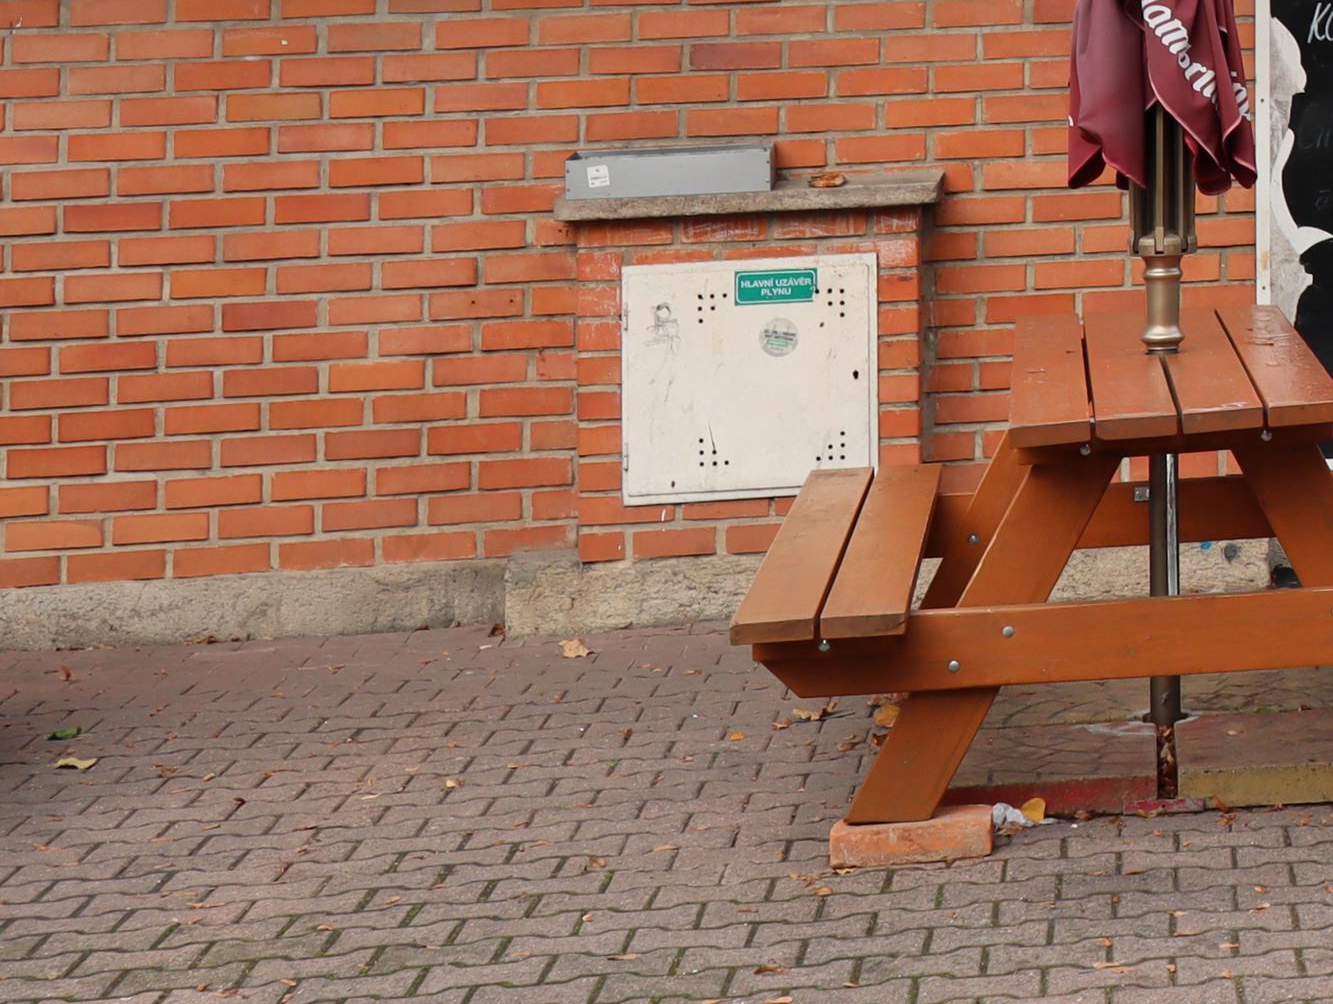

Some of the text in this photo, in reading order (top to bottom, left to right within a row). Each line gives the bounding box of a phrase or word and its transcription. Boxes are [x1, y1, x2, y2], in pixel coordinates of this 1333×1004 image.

[740, 276, 812, 289] HLAVNÍ UZÁVĚR
[760, 287, 792, 296] PLYNU
